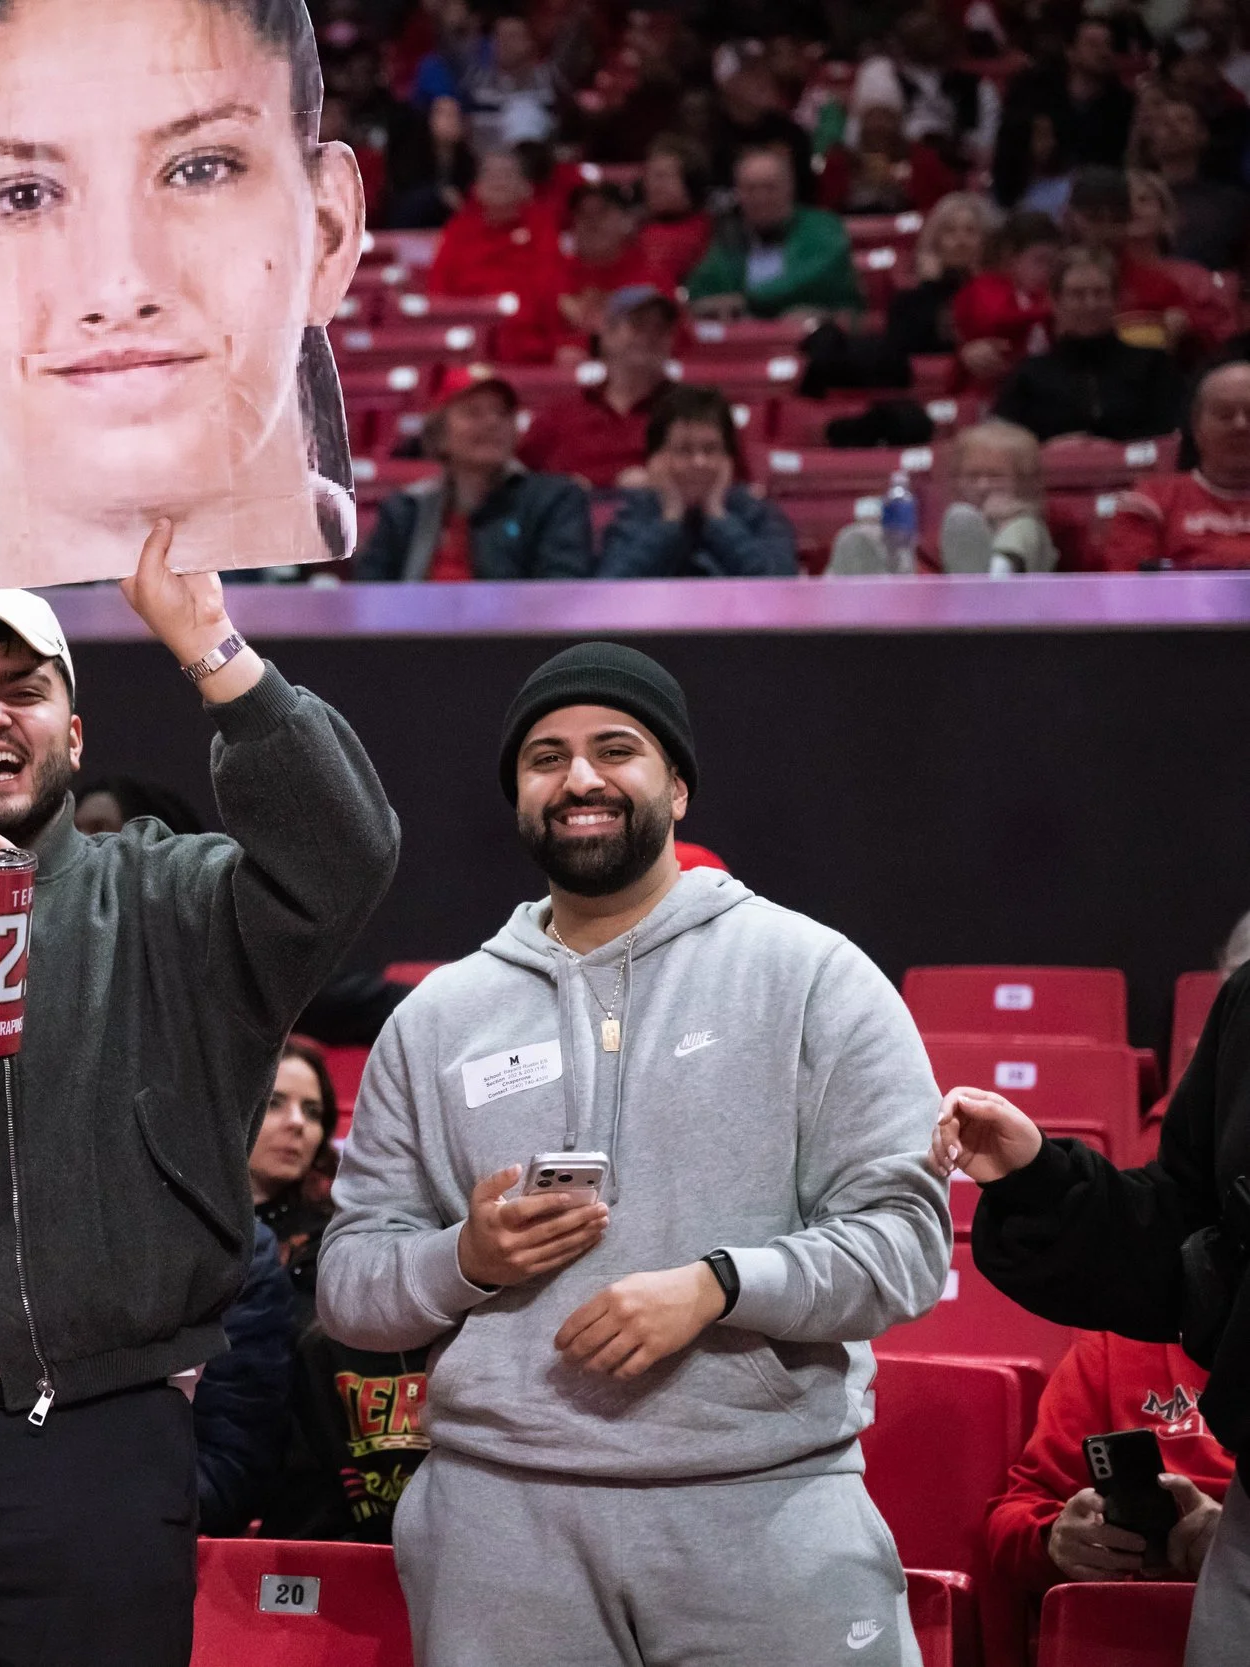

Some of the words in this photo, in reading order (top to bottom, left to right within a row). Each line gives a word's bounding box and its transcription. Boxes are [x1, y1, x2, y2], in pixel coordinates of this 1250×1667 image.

[681, 1030, 713, 1049] NIKE
[509, 1055, 520, 1066] M
[1141, 1384, 1203, 1423] MA
[275, 1583, 304, 1606] 20
[851, 1619, 877, 1637] NIKE
